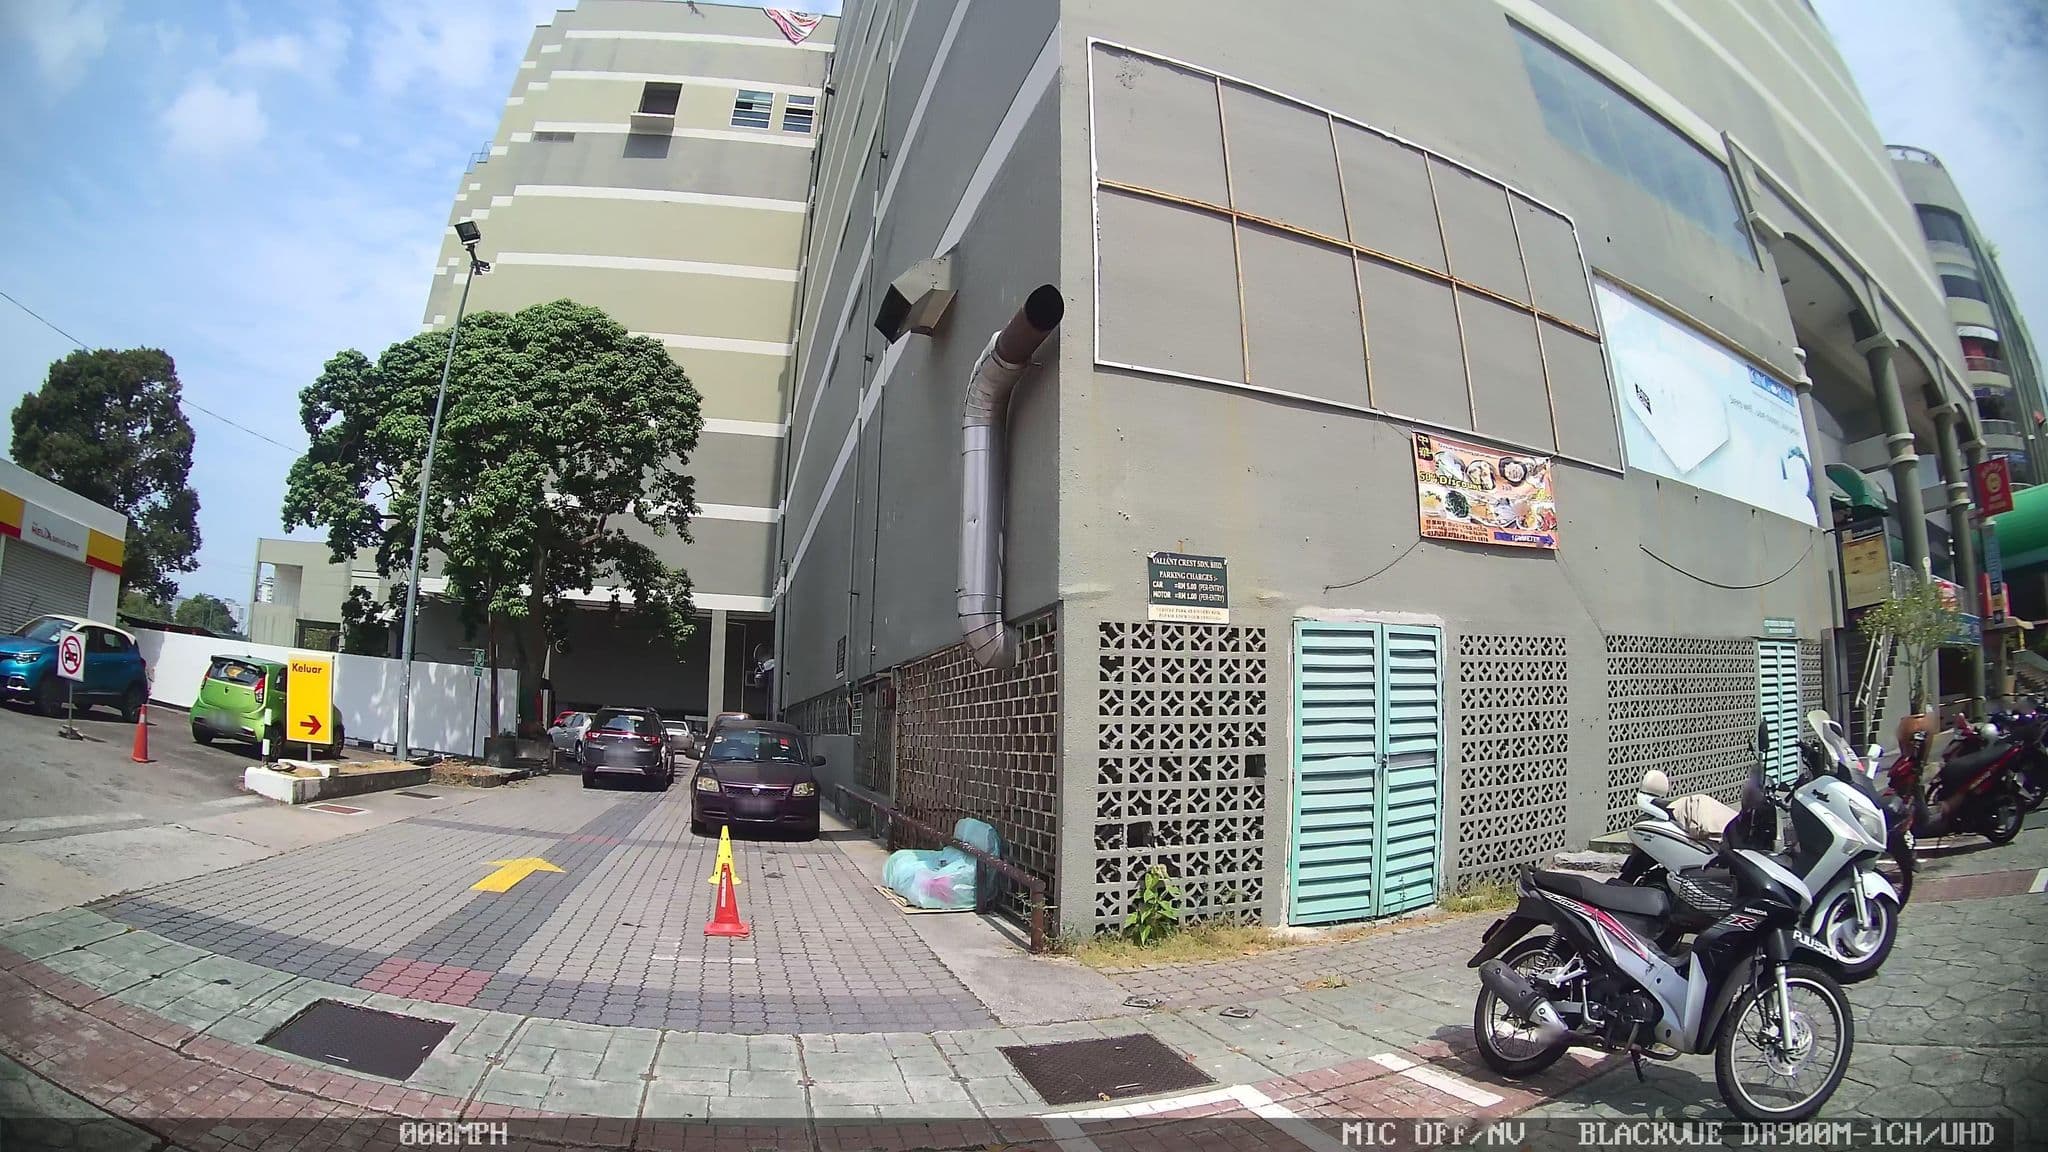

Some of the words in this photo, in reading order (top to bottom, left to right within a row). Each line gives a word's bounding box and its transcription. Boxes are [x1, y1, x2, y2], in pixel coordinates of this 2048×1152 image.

[1439, 475, 1482, 491] Discount
[1178, 559, 1197, 567] CREST
[1160, 571, 1186, 580] PARKING
[1153, 591, 1171, 599] MOTOR
[292, 663, 322, 674] Keluar
[1744, 907, 1768, 917] HONDA
